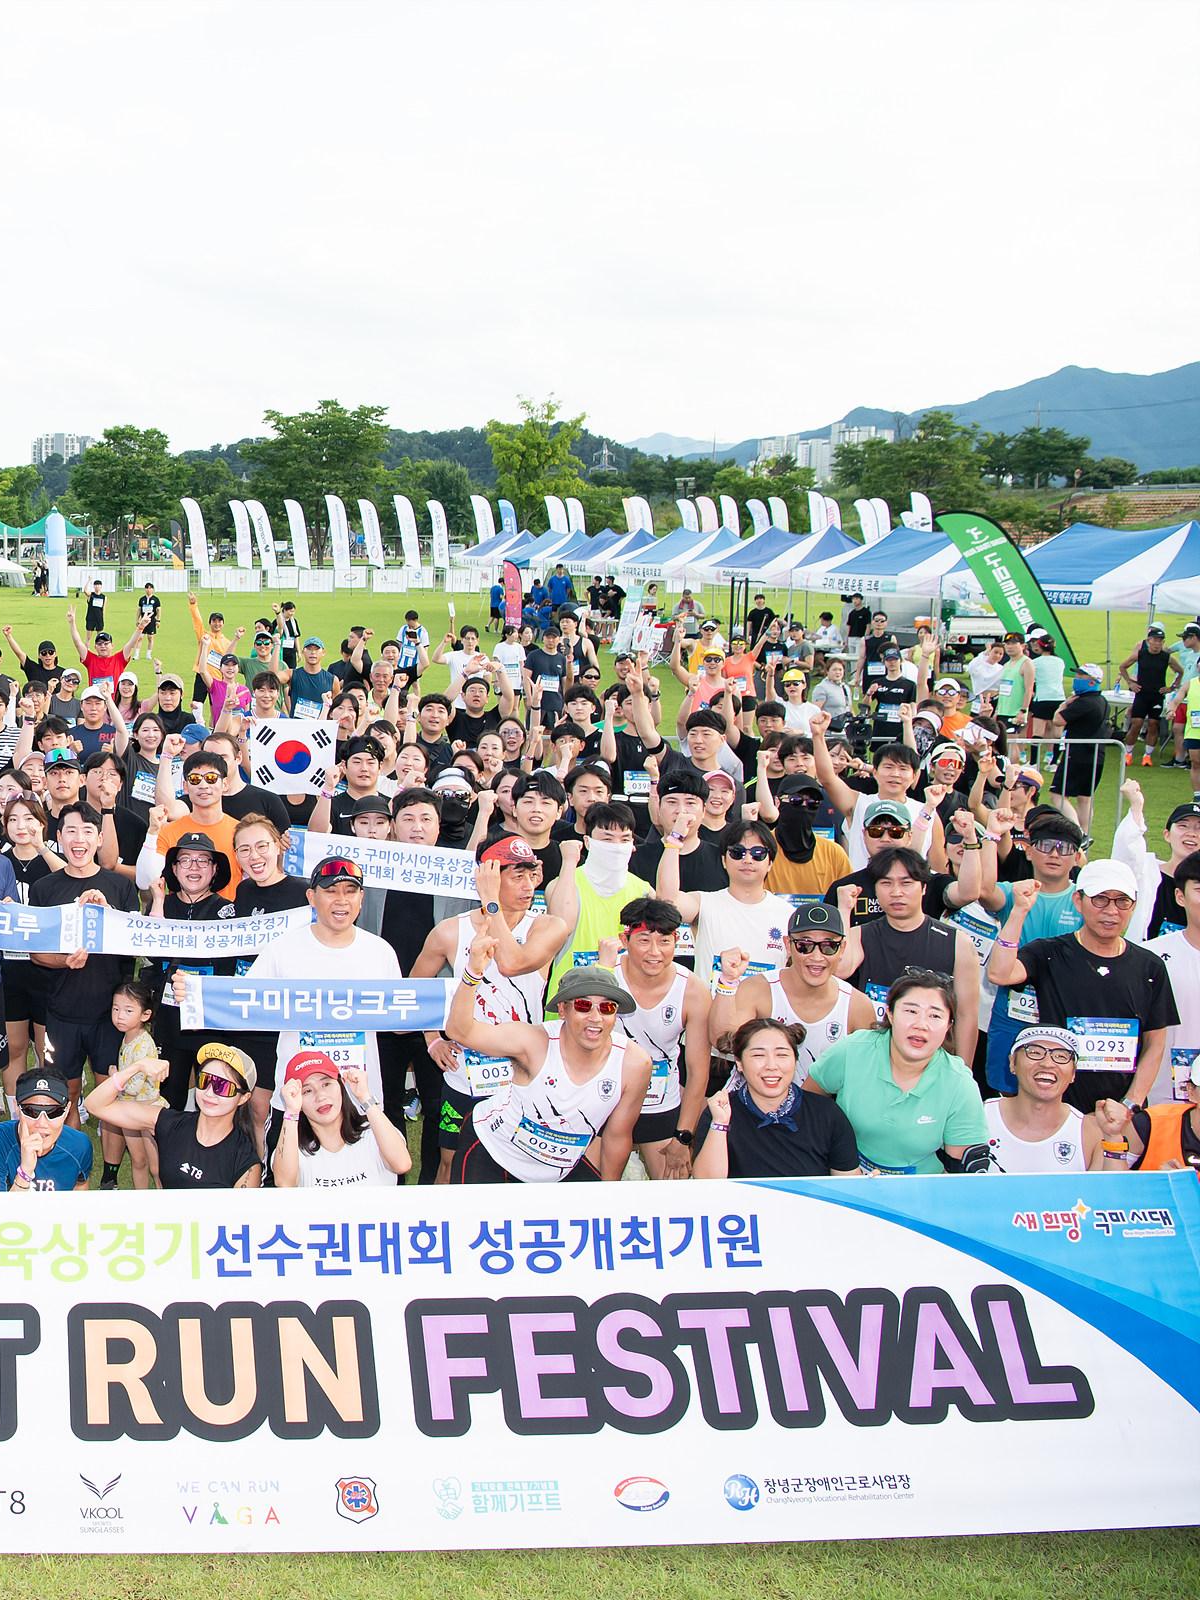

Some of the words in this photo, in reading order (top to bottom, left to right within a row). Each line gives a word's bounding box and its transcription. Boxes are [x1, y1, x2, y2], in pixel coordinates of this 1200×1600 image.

[822, 577, 835, 590] 구미
[866, 580, 879, 593] 크루
[141, 784, 155, 793] 029
[326, 844, 360, 859] 2025
[364, 847, 474, 872] 구미아시아육상경
[360, 863, 395, 881] 권대회
[131, 931, 197, 949] 선수권대회
[228, 987, 421, 1021] 구미러닝크루
[325, 1050, 350, 1061] 183
[1085, 1040, 1125, 1053] 0293
[482, 1067, 509, 1080] 003
[528, 1137, 568, 1156] 0039
[190, 1165, 203, 1180] T8
[1013, 1212, 1038, 1230] 새
[1043, 1212, 1078, 1241] 희망
[1094, 1210, 1127, 1235] 구미
[1130, 1210, 1173, 1226] 시대
[469, 1214, 763, 1277] 성공개최기원
[76, 1308, 372, 1433] RUN
[413, 1292, 1086, 1428] FESTIVAL
[763, 1474, 912, 1494] 창녕군장애인근로사업장
[472, 1493, 562, 1514] 함께기프트
[814, 1494, 848, 1502] Vocational
[848, 1493, 892, 1501] Rehabilitation
[893, 1491, 915, 1500] Center
